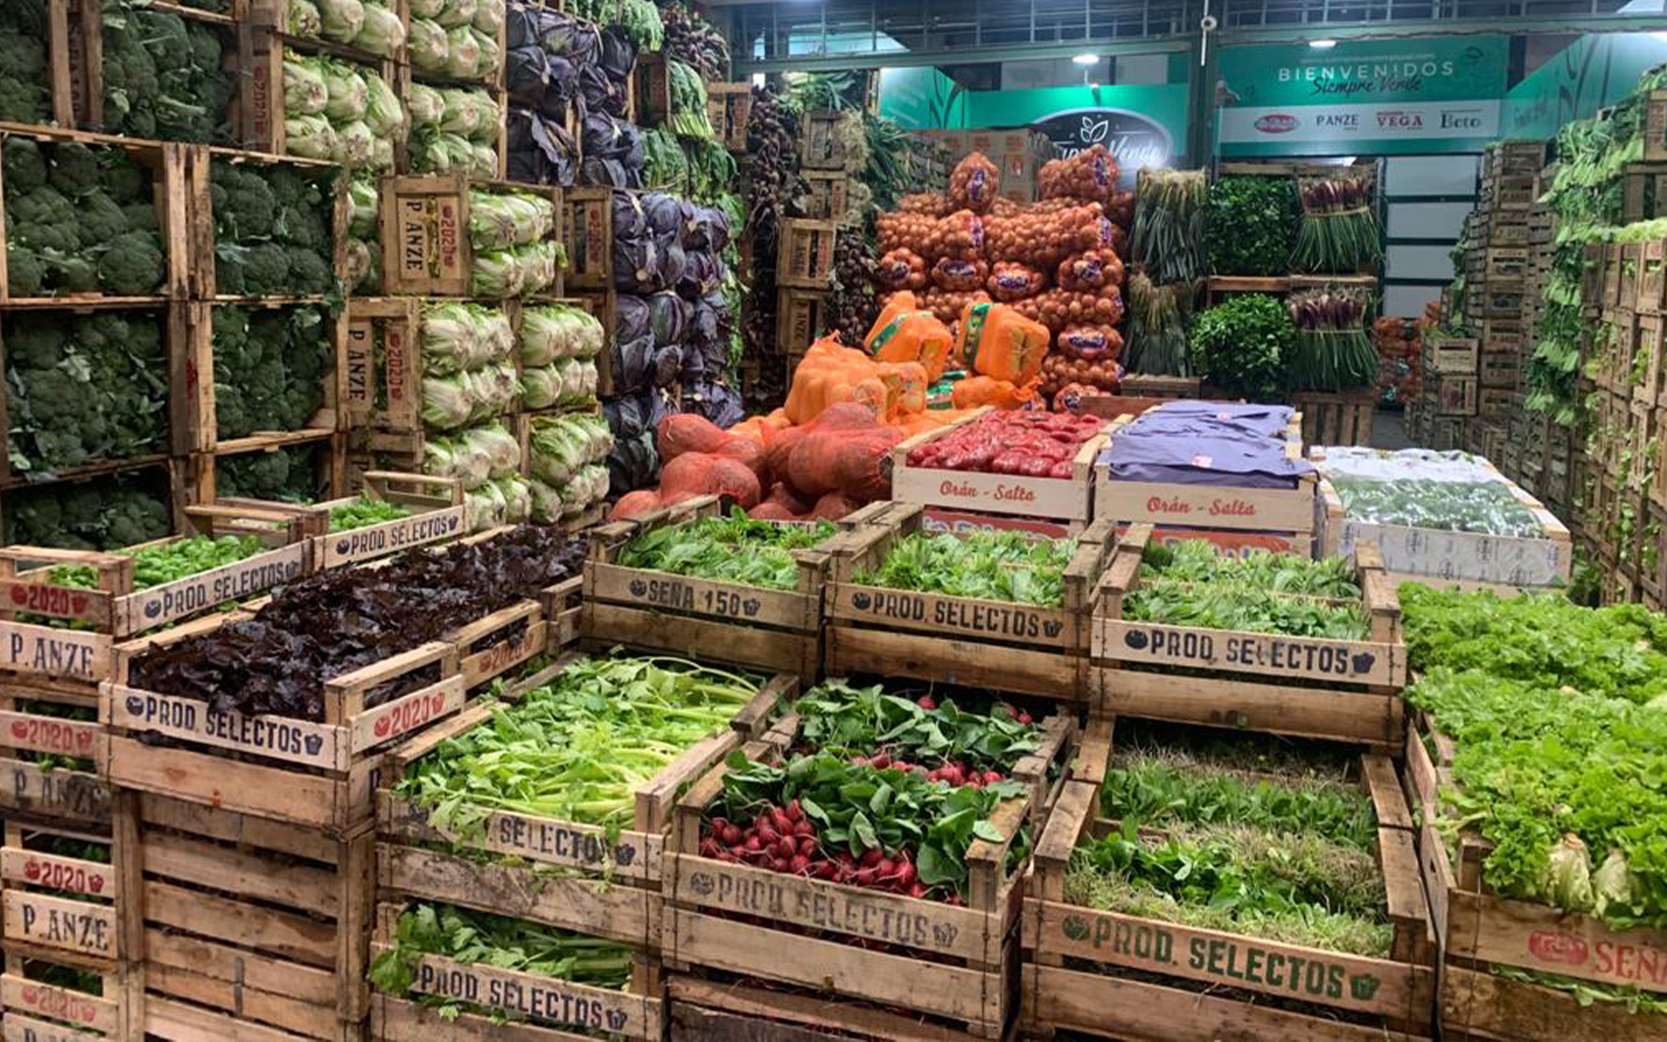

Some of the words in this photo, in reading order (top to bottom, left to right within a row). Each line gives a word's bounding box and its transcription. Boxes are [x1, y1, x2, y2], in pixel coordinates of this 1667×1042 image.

[1278, 62, 1453, 82] BIENVENIDOS
[1309, 77, 1373, 97] Siempre
[1377, 115, 1423, 127] VEGA
[441, 220, 456, 254] 2020
[388, 349, 403, 385] 2020
[939, 480, 979, 497] Orán
[993, 484, 1037, 501] Salta
[1147, 495, 1191, 514] Orán
[1209, 499, 1256, 516] Salta
[391, 515, 448, 547] SELECTOS
[213, 560, 285, 600] SELECTOS
[29, 584, 70, 615] 2020
[703, 589, 740, 616] 150
[872, 592, 928, 623] PROD.
[935, 599, 1040, 638] SELECTOS
[1226, 638, 1349, 674] SELECTOS
[391, 695, 430, 733] 2020
[28, 719, 74, 751] 2020
[205, 711, 302, 755] SELECTOS
[501, 814, 607, 864] SELECTO
[41, 861, 86, 894] 2020
[795, 888, 929, 945] SELECTOS
[1092, 913, 1179, 966] PROD.
[1187, 936, 1346, 1001] SELECTOS
[489, 978, 604, 1028] SELECTOS
